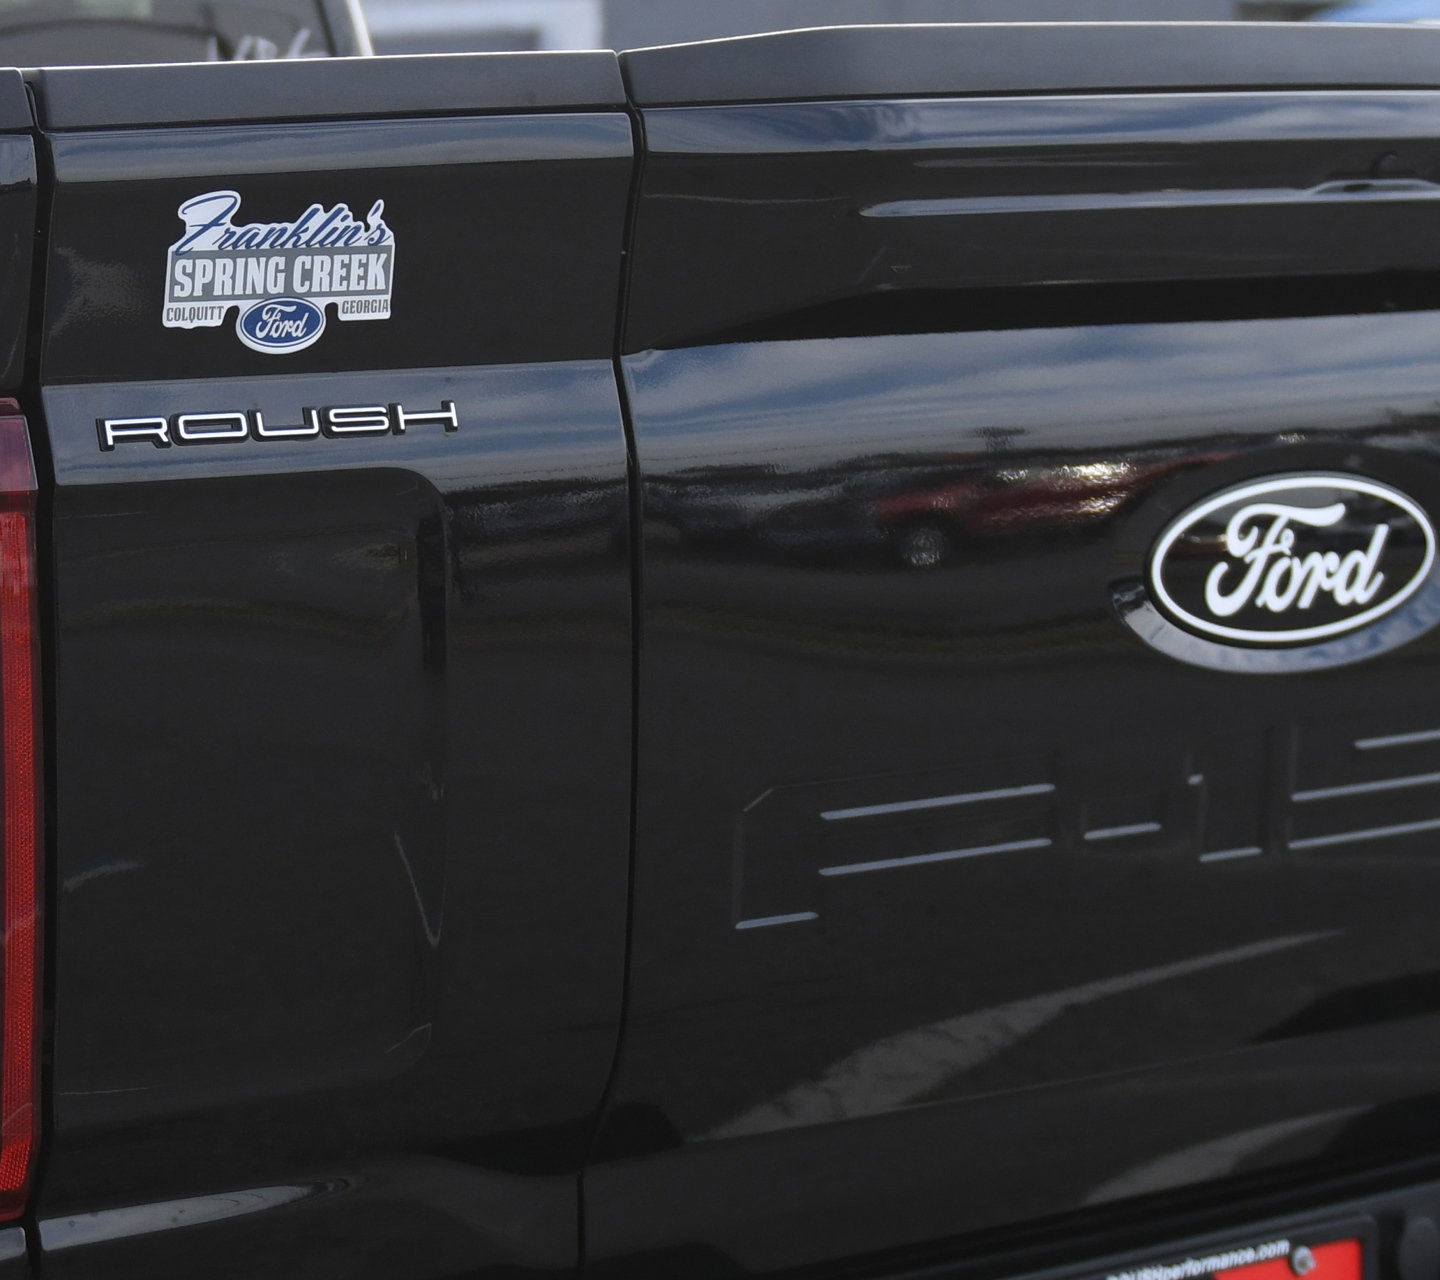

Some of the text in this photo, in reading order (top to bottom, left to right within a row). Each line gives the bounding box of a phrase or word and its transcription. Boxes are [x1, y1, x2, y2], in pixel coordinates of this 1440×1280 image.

[174, 194, 391, 257] Franklin's
[173, 252, 388, 298] SPRING CREEK
[165, 305, 225, 324] COLQUITT
[255, 303, 309, 340] Ford
[341, 298, 389, 315] GEORGIA
[100, 399, 459, 449] ROUSH
[1204, 501, 1390, 617] Ford
